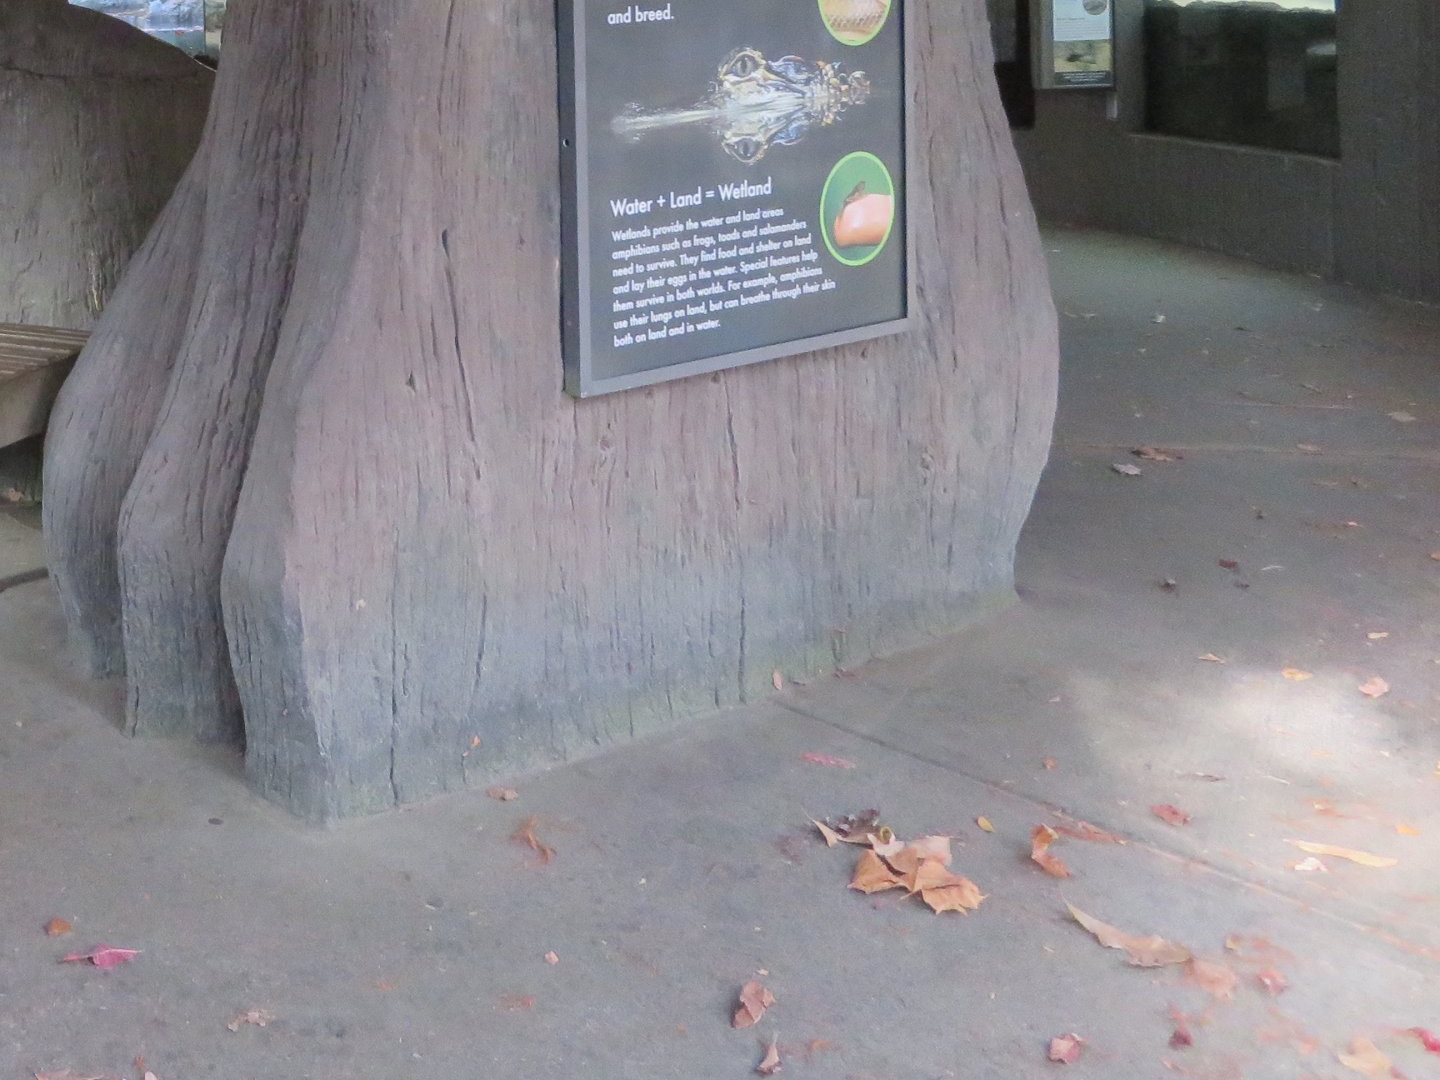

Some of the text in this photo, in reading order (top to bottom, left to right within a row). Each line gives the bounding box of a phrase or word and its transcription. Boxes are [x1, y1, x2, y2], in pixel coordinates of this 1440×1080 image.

[608, 3, 674, 25] and breed.
[610, 176, 772, 217] Water + Land = Wetland
[612, 207, 784, 242] Wetlands provide the water and land areas
[612, 219, 807, 261] amphibians such as frogs, toads and salamanders
[613, 233, 812, 278] need to survive. They find food and shelter on land
[613, 249, 818, 295] and lay their eggs in the water. Special features help
[613, 266, 822, 312] them survive in both worlds. For example, amphibians
[614, 278, 836, 329] use their lungs on land, but can breathe through their skin
[614, 318, 720, 347] both on land and in water.
